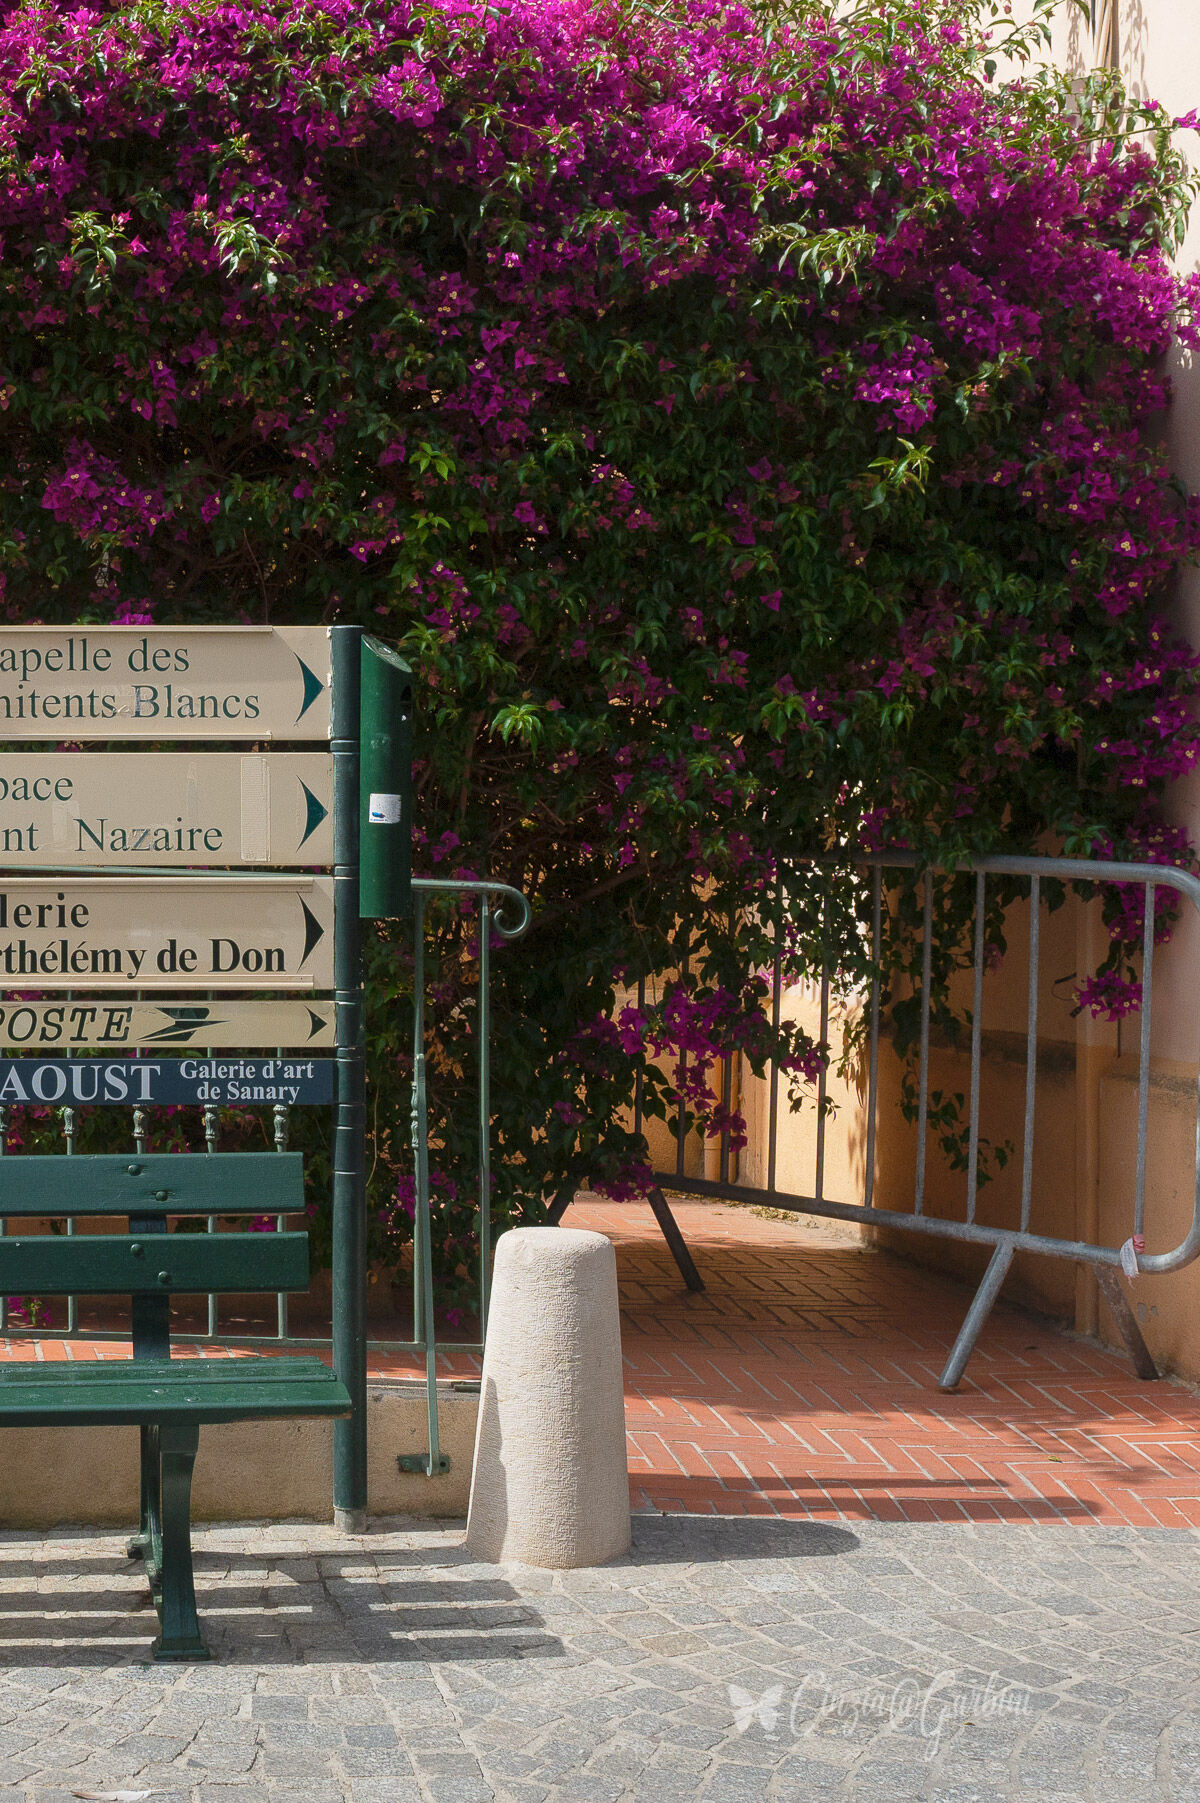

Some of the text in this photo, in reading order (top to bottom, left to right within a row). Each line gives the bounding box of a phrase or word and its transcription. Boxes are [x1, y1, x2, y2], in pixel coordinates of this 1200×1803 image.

[127, 637, 190, 673] des
[130, 683, 260, 719] Blancs
[72, 816, 223, 852] Nazaire
[156, 938, 198, 974] de
[208, 938, 287, 973] Don
[179, 1060, 315, 1079] Galerie d'art
[196, 1080, 301, 1105] de Sanary
